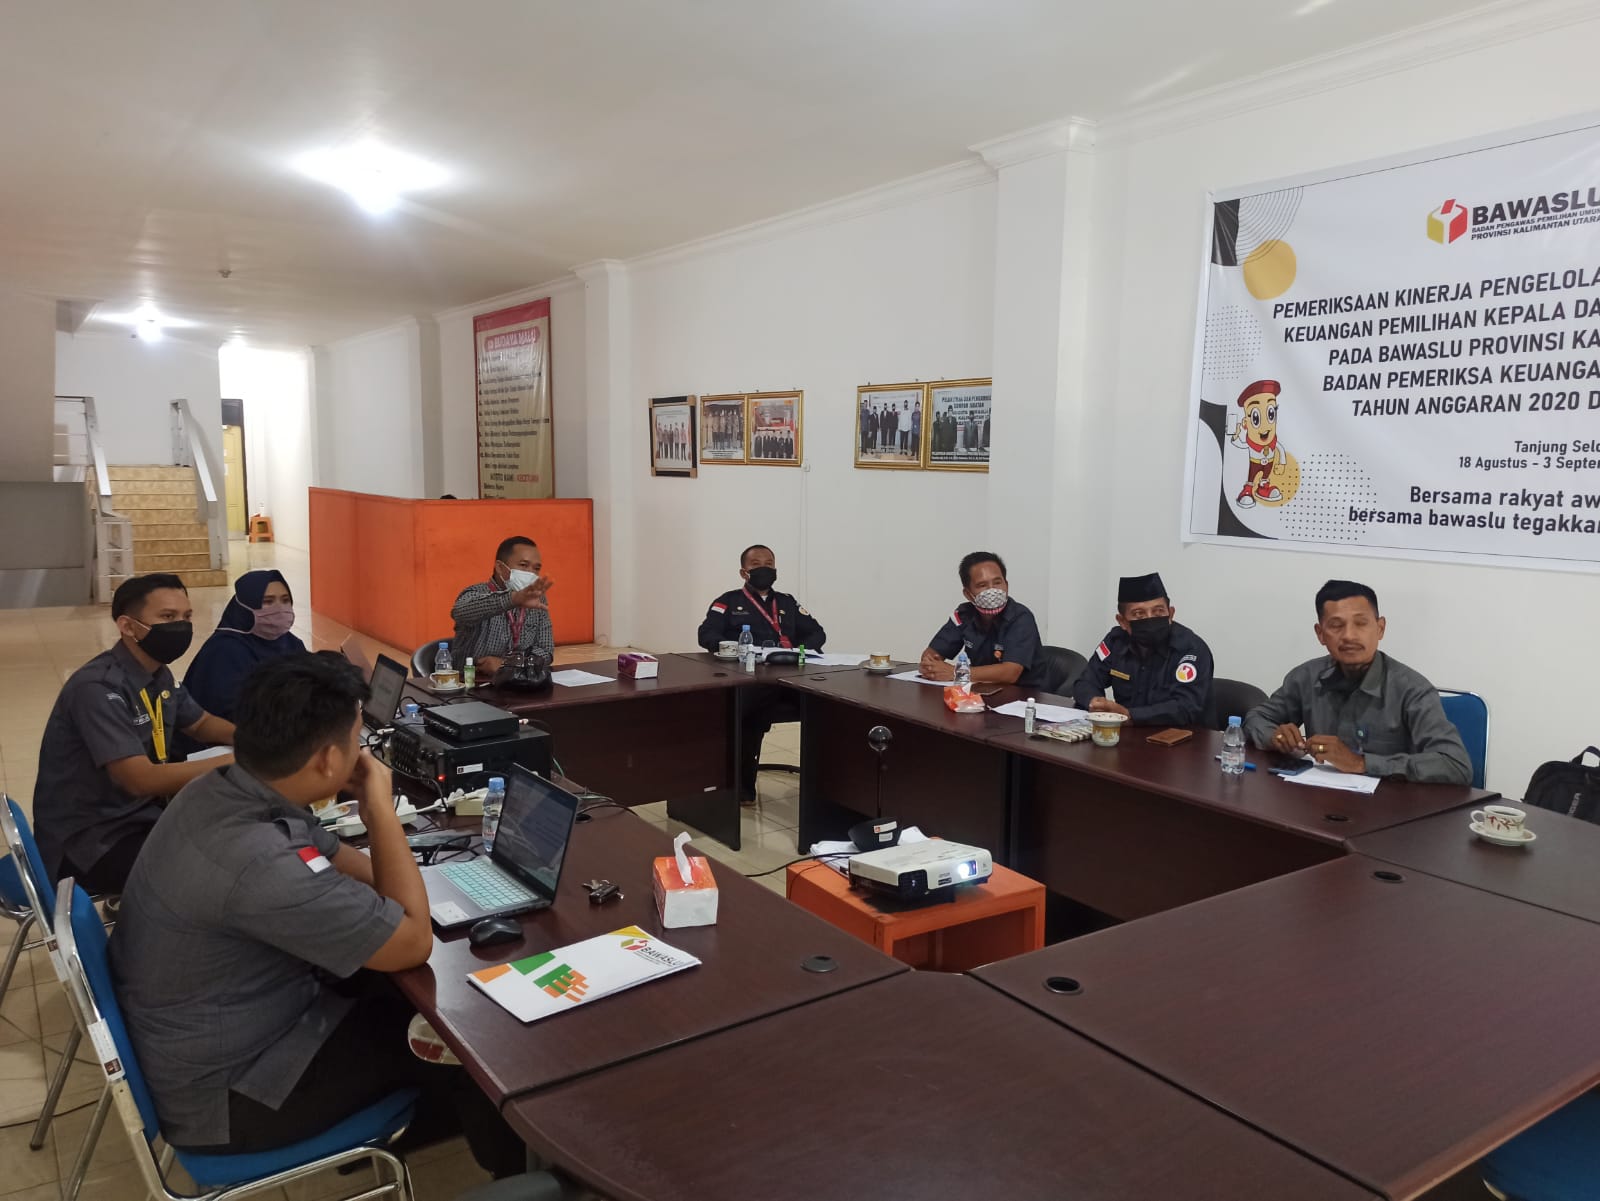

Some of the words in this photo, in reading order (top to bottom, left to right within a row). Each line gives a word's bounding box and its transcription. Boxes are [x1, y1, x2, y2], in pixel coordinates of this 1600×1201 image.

[1472, 187, 1600, 226] BAWASLU
[1471, 225, 1495, 233] BADAN
[1496, 218, 1536, 229] PENGAWAS
[1537, 211, 1578, 223] PEMILIHAN
[1471, 229, 1511, 240] PROVINSI
[1513, 219, 1571, 235] KALIMANTAN
[1273, 291, 1389, 319] PEMERIKSAAN
[1395, 281, 1473, 307] KINERJA
[1479, 266, 1600, 298] PENGELOLA
[1284, 319, 1373, 343] KEUANGAN
[1379, 309, 1477, 336] PEMILIHAN
[1484, 301, 1566, 327] KEPALA
[1574, 297, 1600, 318] DA
[1328, 346, 1373, 365] PADA
[1378, 339, 1462, 363] BAWASLU
[1469, 331, 1565, 356] PROVINSI
[1572, 328, 1600, 349] KA
[1322, 372, 1381, 391] BADAN
[1387, 366, 1493, 389] PEMERIKSA
[1500, 359, 1600, 383] KEUANGA
[1352, 398, 1409, 416] TAHUN
[1414, 393, 1522, 415] ANGGARAN
[1528, 391, 1580, 411] 2020
[1588, 390, 1600, 409] D
[1514, 440, 1567, 455] Tanjung
[1459, 456, 1471, 468] 18
[1475, 456, 1528, 471] Agustus
[1543, 456, 1551, 468] 3
[1556, 457, 1600, 472] Septe
[1410, 486, 1493, 505] Bersama
[1499, 489, 1564, 512] rakyat
[1571, 494, 1600, 509] aw
[1348, 506, 1422, 525] bersama
[1429, 509, 1506, 530] bawaslu
[1513, 513, 1600, 536] tegakka
